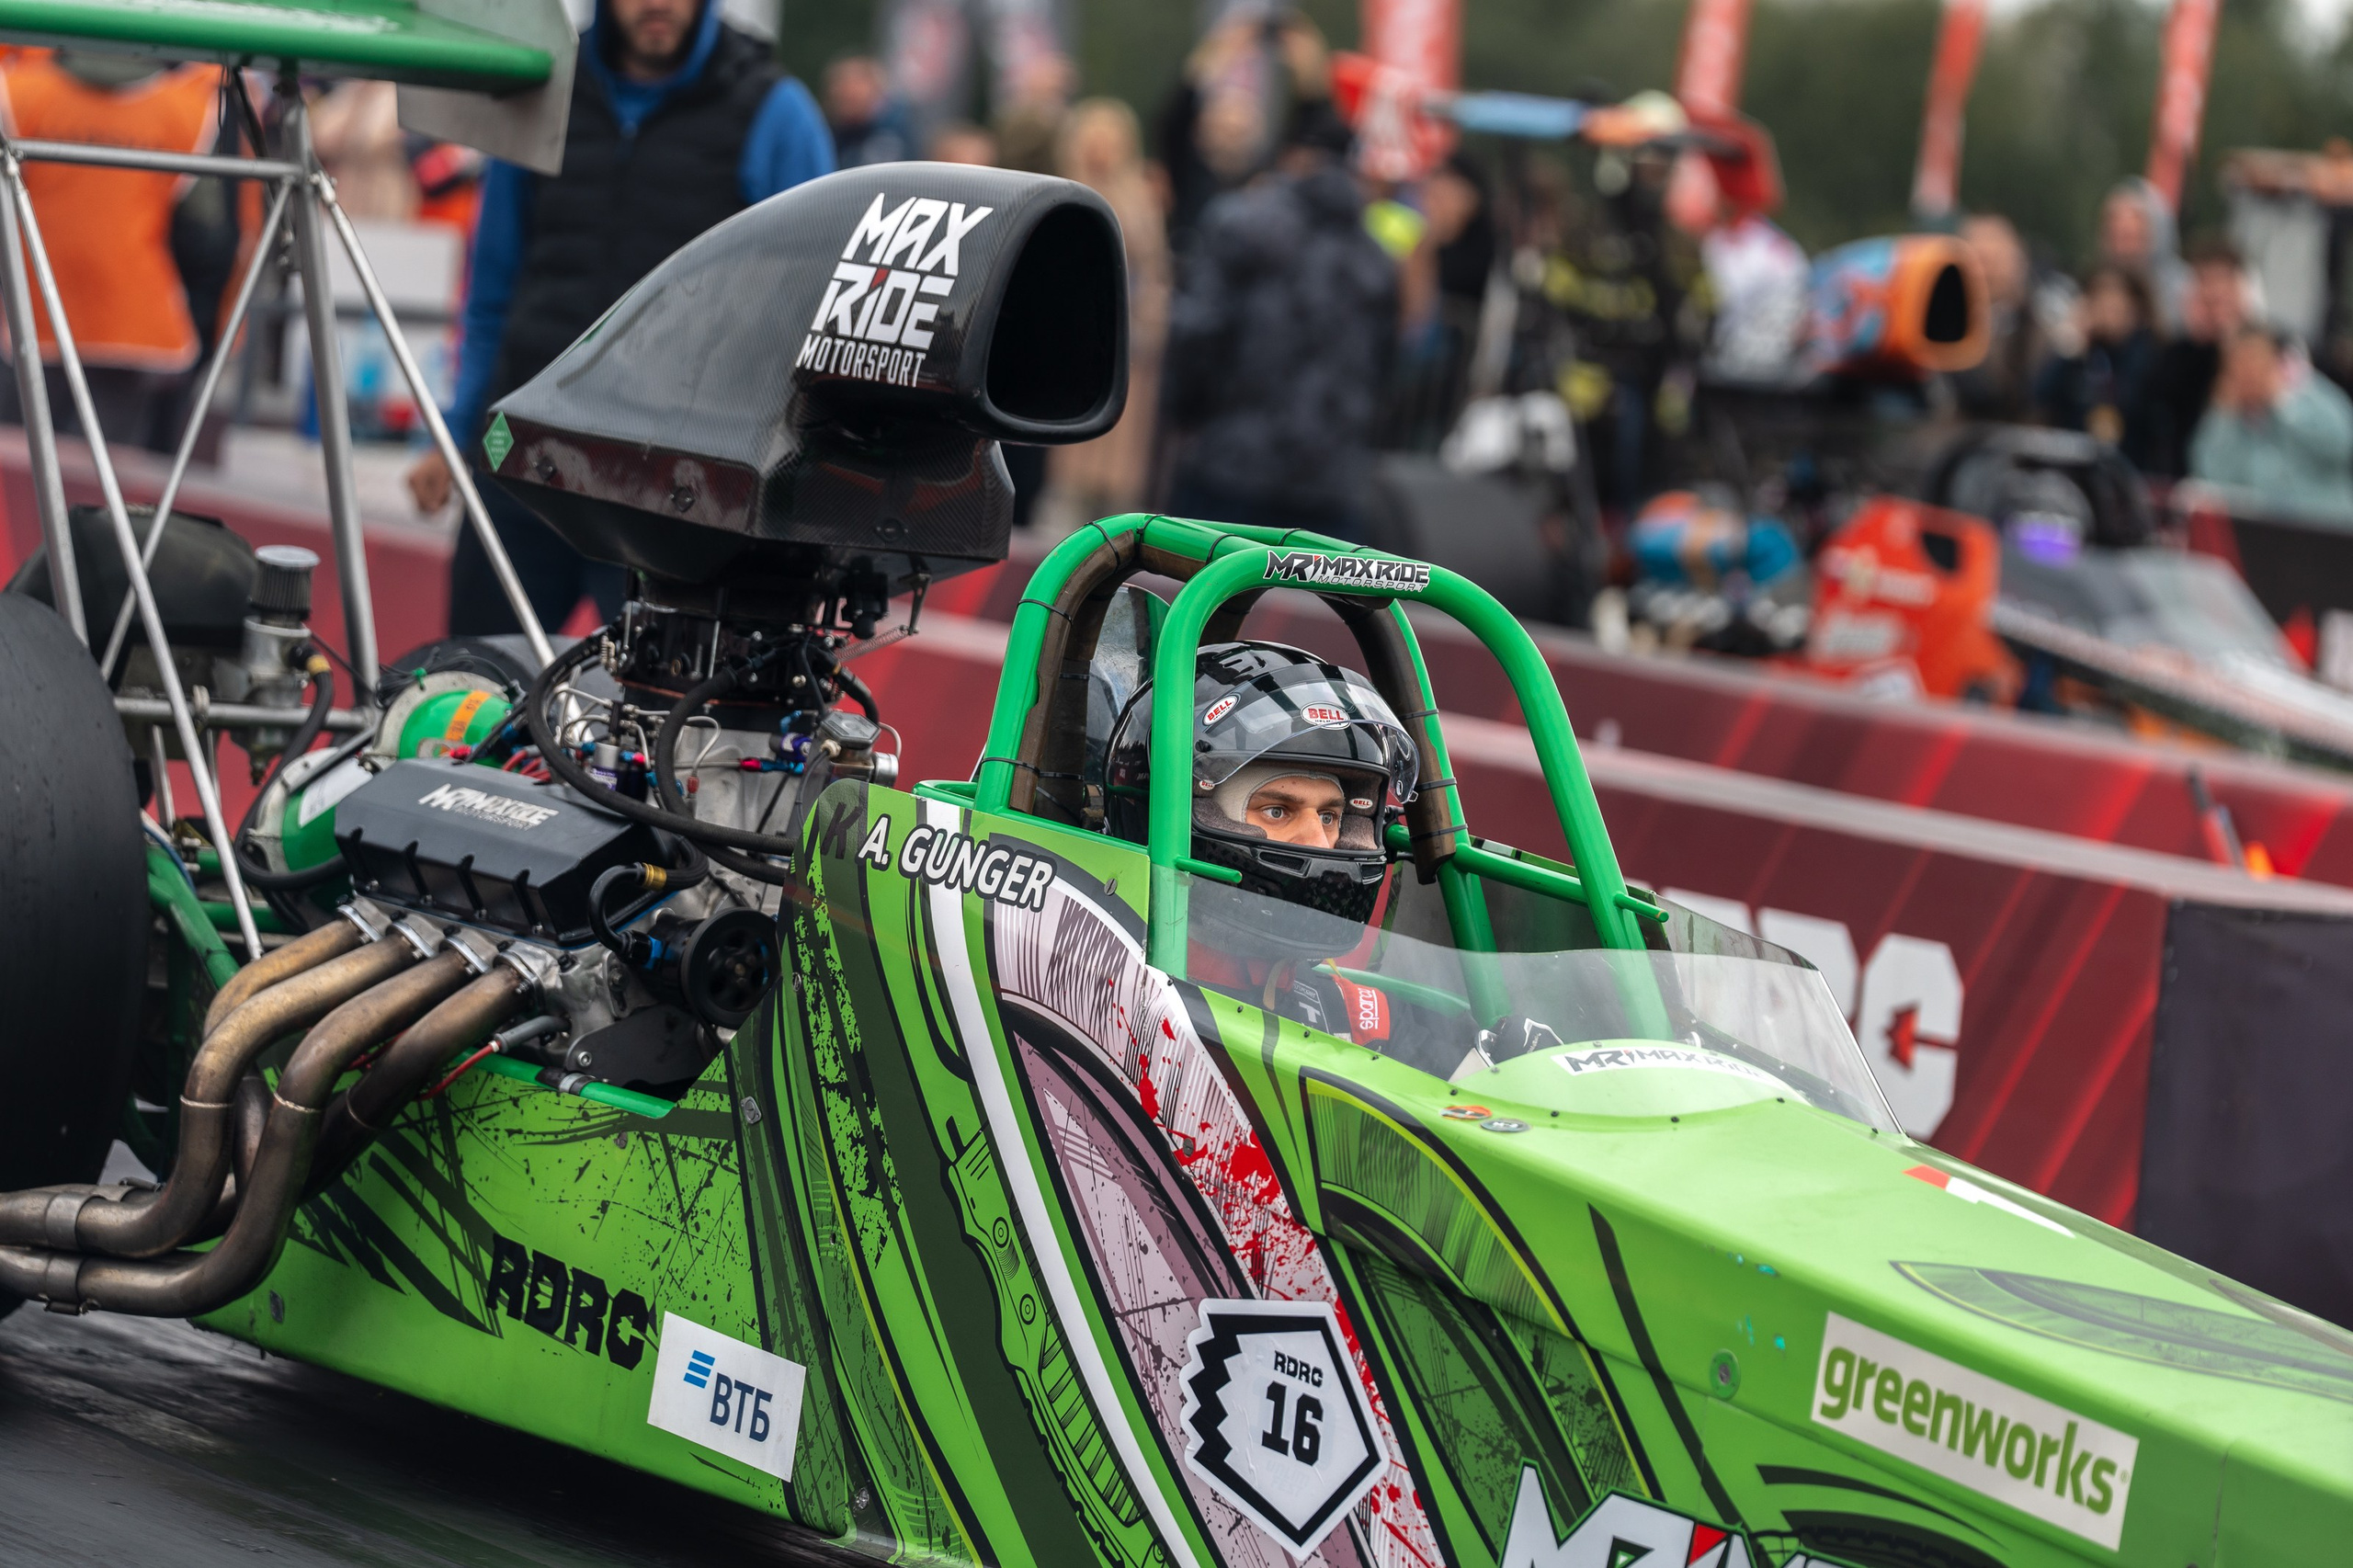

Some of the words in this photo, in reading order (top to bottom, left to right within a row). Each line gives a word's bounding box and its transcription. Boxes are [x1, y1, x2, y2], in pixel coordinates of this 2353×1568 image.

[841, 192, 994, 277] MAX
[795, 334, 926, 388] MOTORSPORT
[1316, 574, 1427, 592] MOTORSPORT
[1207, 700, 1233, 721] BELL
[1308, 708, 1344, 721] BELL
[857, 815, 891, 867] A.
[900, 825, 1055, 911] GUNGER
[486, 1233, 648, 1370] RDRC
[1274, 1350, 1324, 1388] RDRC
[710, 1372, 774, 1443] ВТБ
[1262, 1381, 1324, 1466] 16
[1820, 1346, 2118, 1515] greenworks
